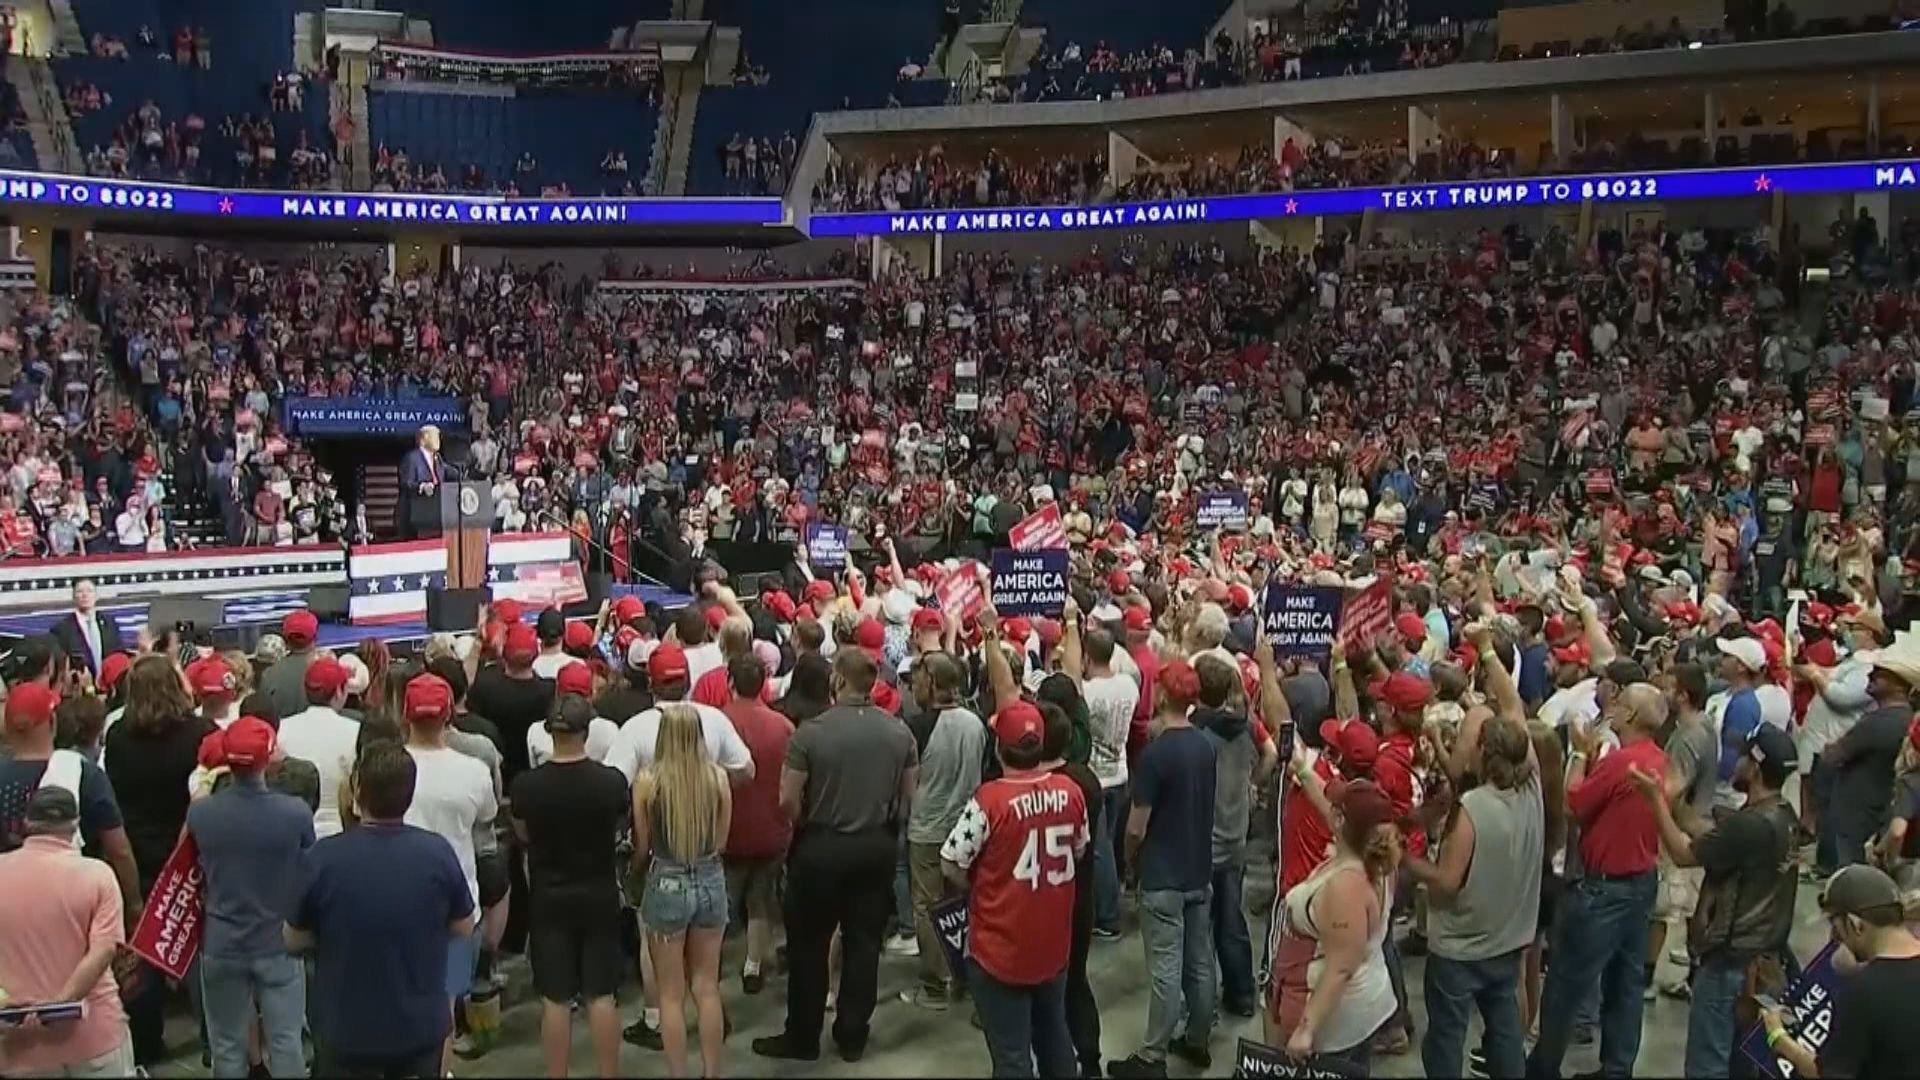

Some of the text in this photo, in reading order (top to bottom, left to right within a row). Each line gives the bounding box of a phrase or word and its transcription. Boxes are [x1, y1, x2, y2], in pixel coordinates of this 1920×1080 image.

[56, 184, 89, 201] TO
[100, 188, 174, 208] 88022
[1382, 179, 1657, 207] TEXT TRUMP TO 88022
[283, 199, 627, 222] MAKE AMERICA GREAT AGAIN!
[891, 203, 1206, 231] MAKE AMERICA GREAT AGAIN!
[293, 410, 324, 420] MAKE
[329, 411, 381, 420] AMERICA
[385, 412, 422, 421] GREAT
[1013, 559, 1043, 571] MAKE
[993, 573, 1064, 590] AMERICA
[992, 592, 1028, 605] GREAT
[1286, 596, 1315, 609] MAKE
[1266, 611, 1333, 630] AMERICA
[1009, 790, 1068, 821] TRUMP
[1013, 824, 1076, 892] 45
[154, 870, 183, 919] MAKE
[168, 911, 197, 966] GREAT
[1789, 984, 1828, 1034] AKE
[1242, 1055, 1298, 1078] AGAIN
